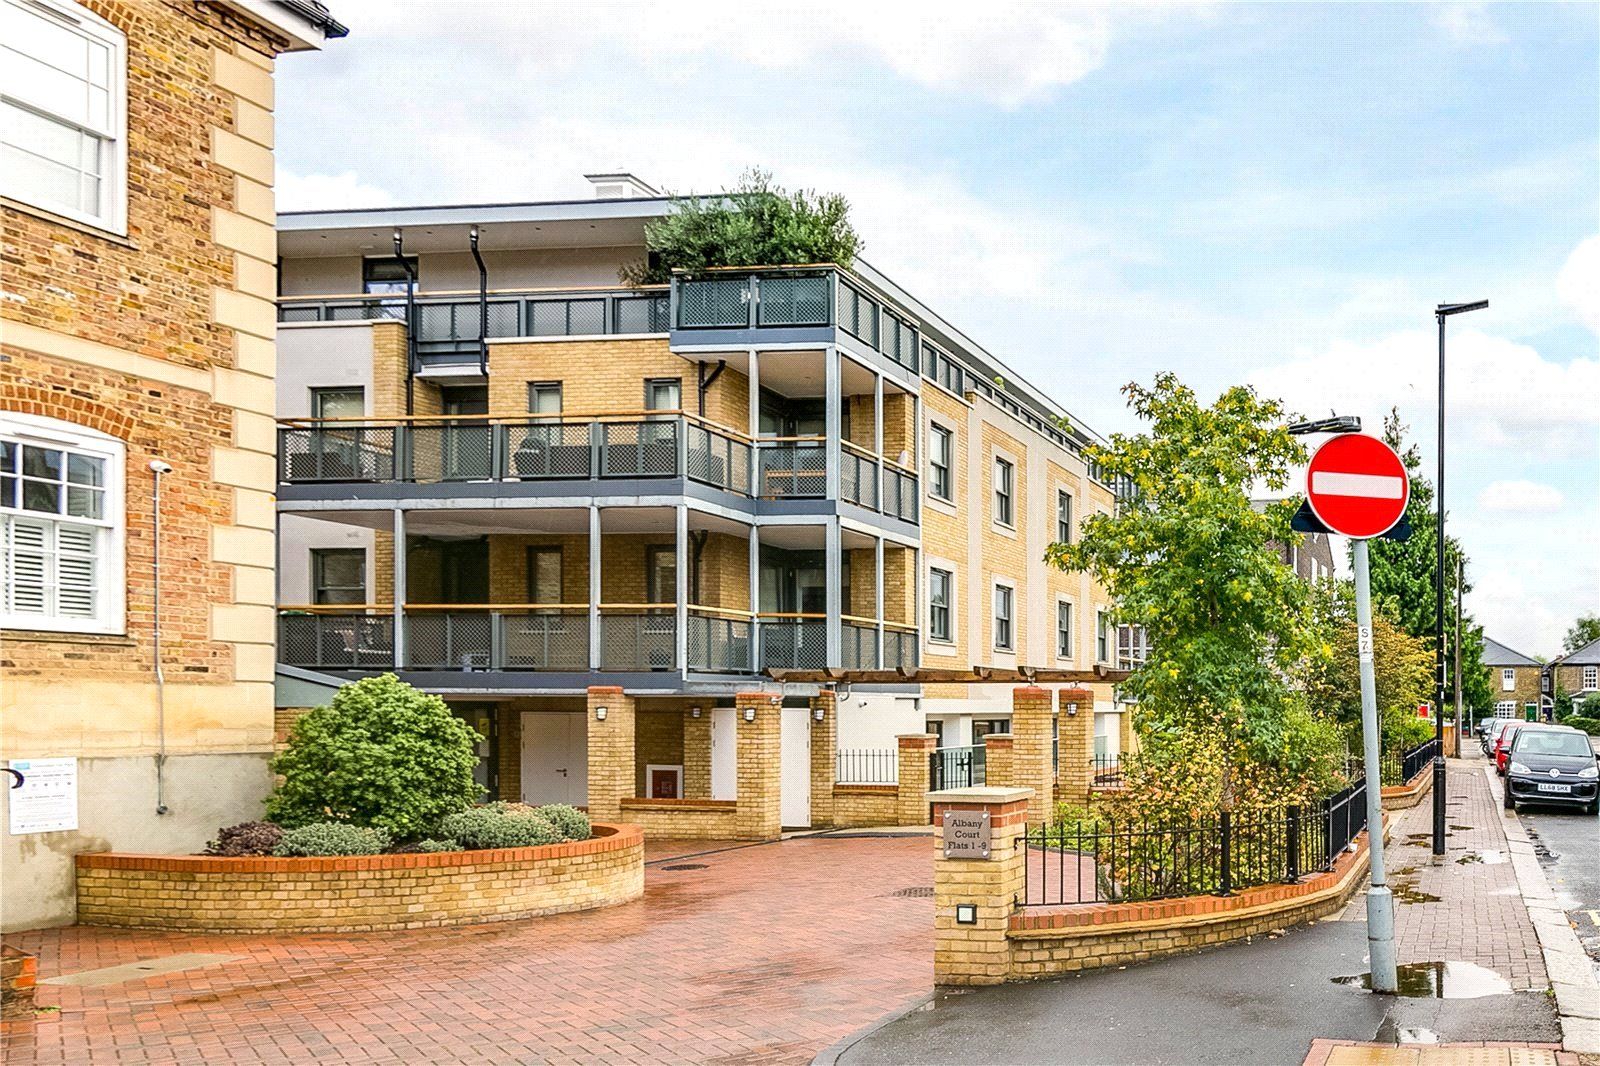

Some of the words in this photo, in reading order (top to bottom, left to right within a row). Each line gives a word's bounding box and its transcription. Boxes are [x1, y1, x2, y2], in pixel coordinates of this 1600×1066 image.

[951, 819, 982, 829] Albany
[954, 830, 980, 838] Court
[947, 841, 968, 849] Flats
